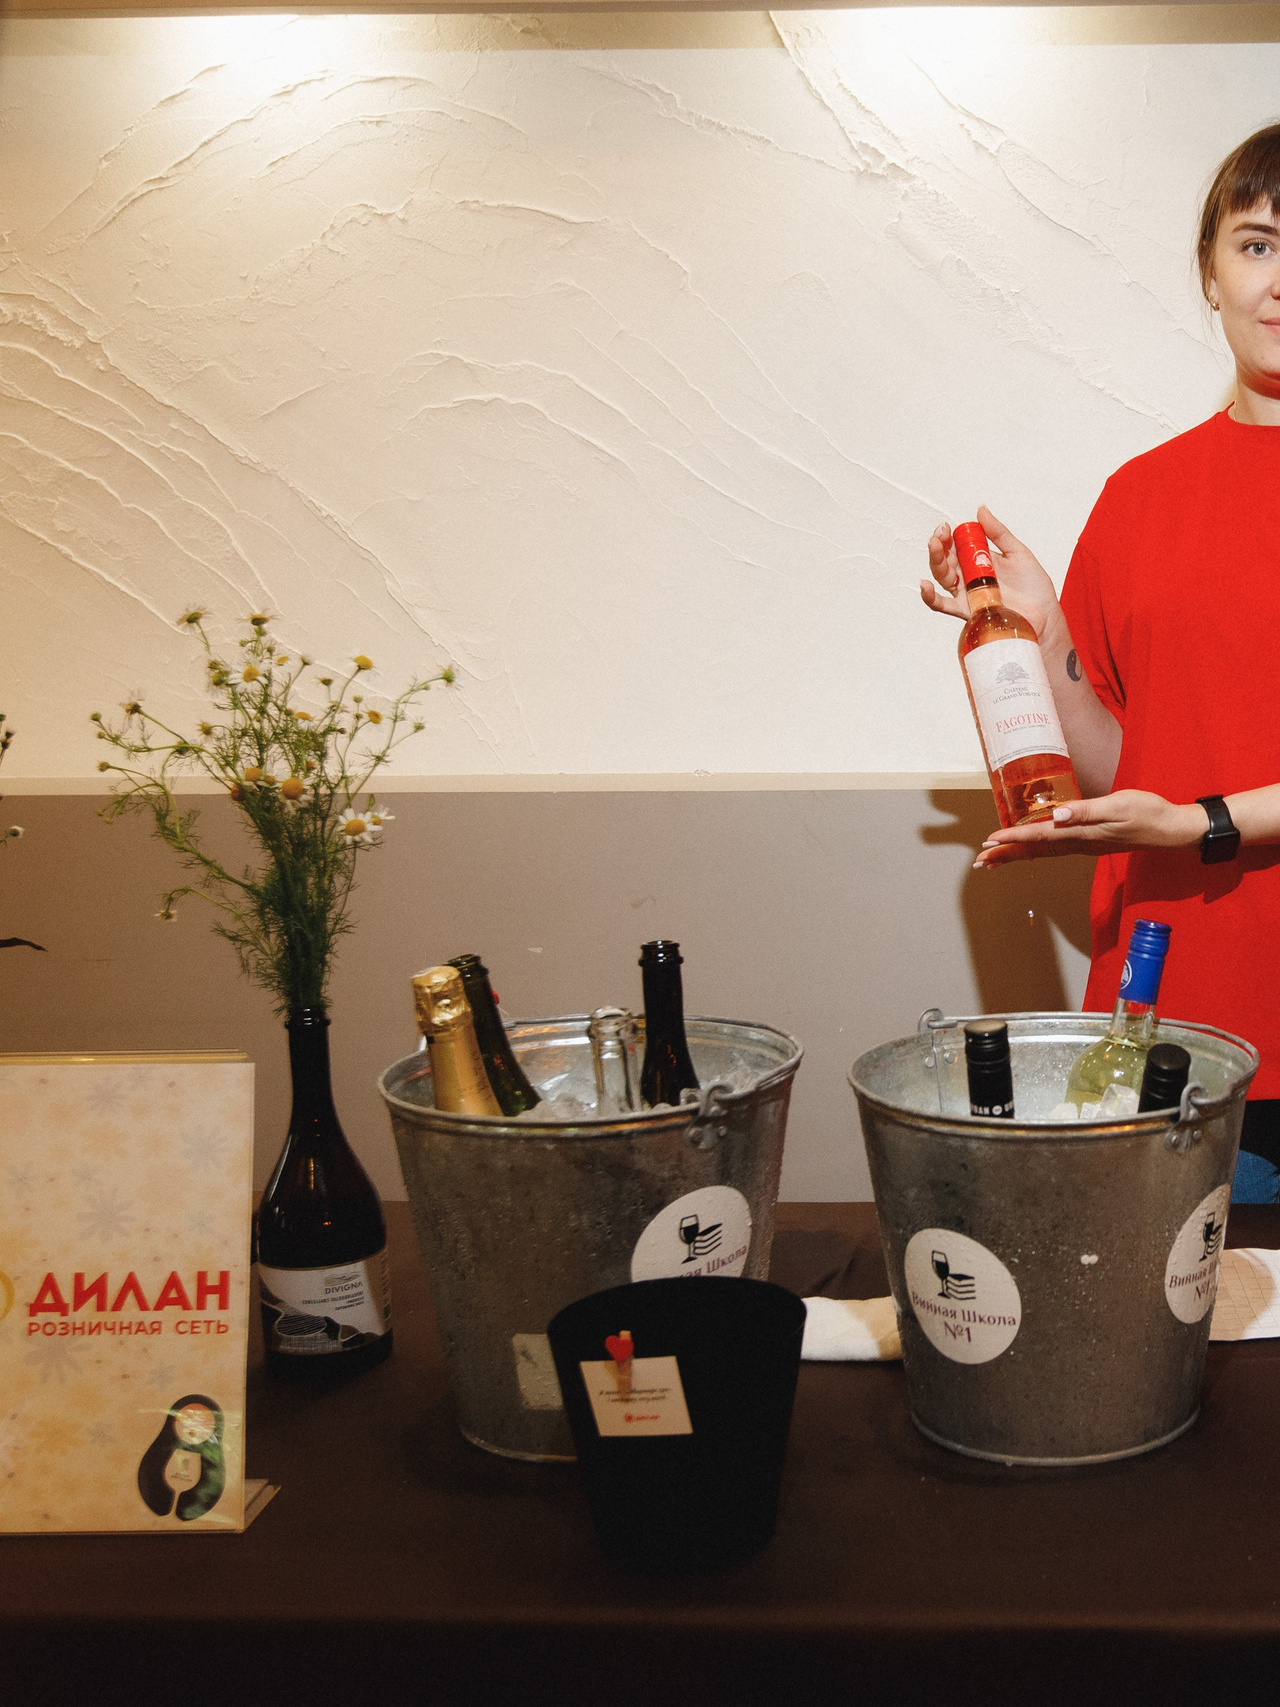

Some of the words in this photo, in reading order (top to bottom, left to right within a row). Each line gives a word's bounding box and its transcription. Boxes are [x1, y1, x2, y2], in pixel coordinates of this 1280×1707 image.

[996, 713, 1051, 733] FAGOTINE
[706, 1245, 748, 1275] Школа
[325, 1281, 363, 1294] DIVIGNA
[1168, 1267, 1207, 1289] Винная
[28, 1270, 230, 1317] ДИЛАН
[1193, 1279, 1211, 1301] №1
[911, 1290, 957, 1320] Винная
[961, 1308, 1017, 1326] Школа
[27, 1320, 162, 1336] РОЗНИЧНАЯ
[175, 1319, 229, 1335] СЕТЬ
[943, 1320, 972, 1344] №1
